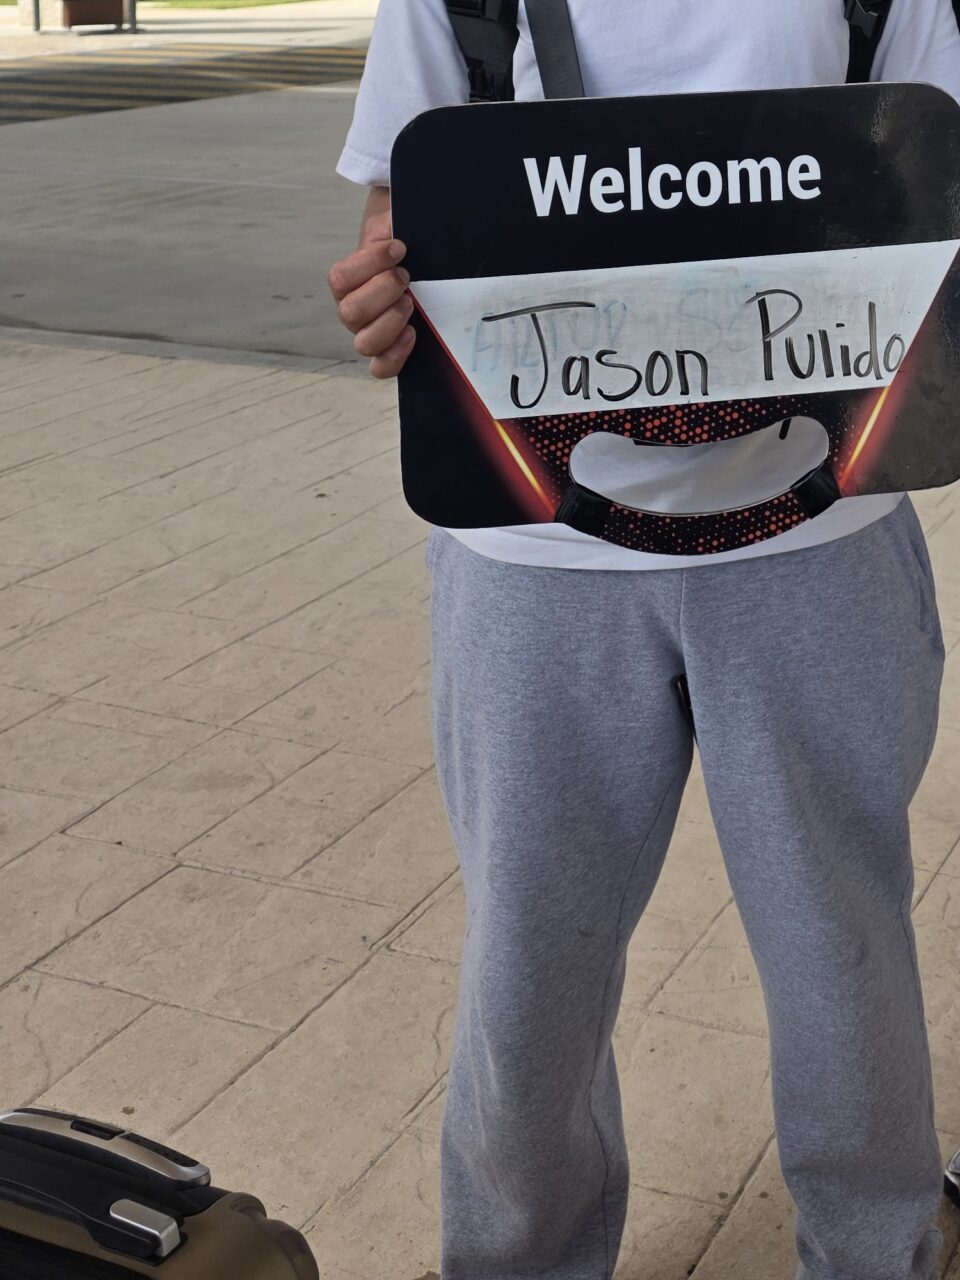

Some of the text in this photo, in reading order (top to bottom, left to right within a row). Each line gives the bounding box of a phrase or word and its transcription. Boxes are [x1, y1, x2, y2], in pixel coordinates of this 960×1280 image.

[523, 147, 822, 217] Welcome
[482, 300, 709, 410] Jason
[745, 288, 905, 381] Pulido
